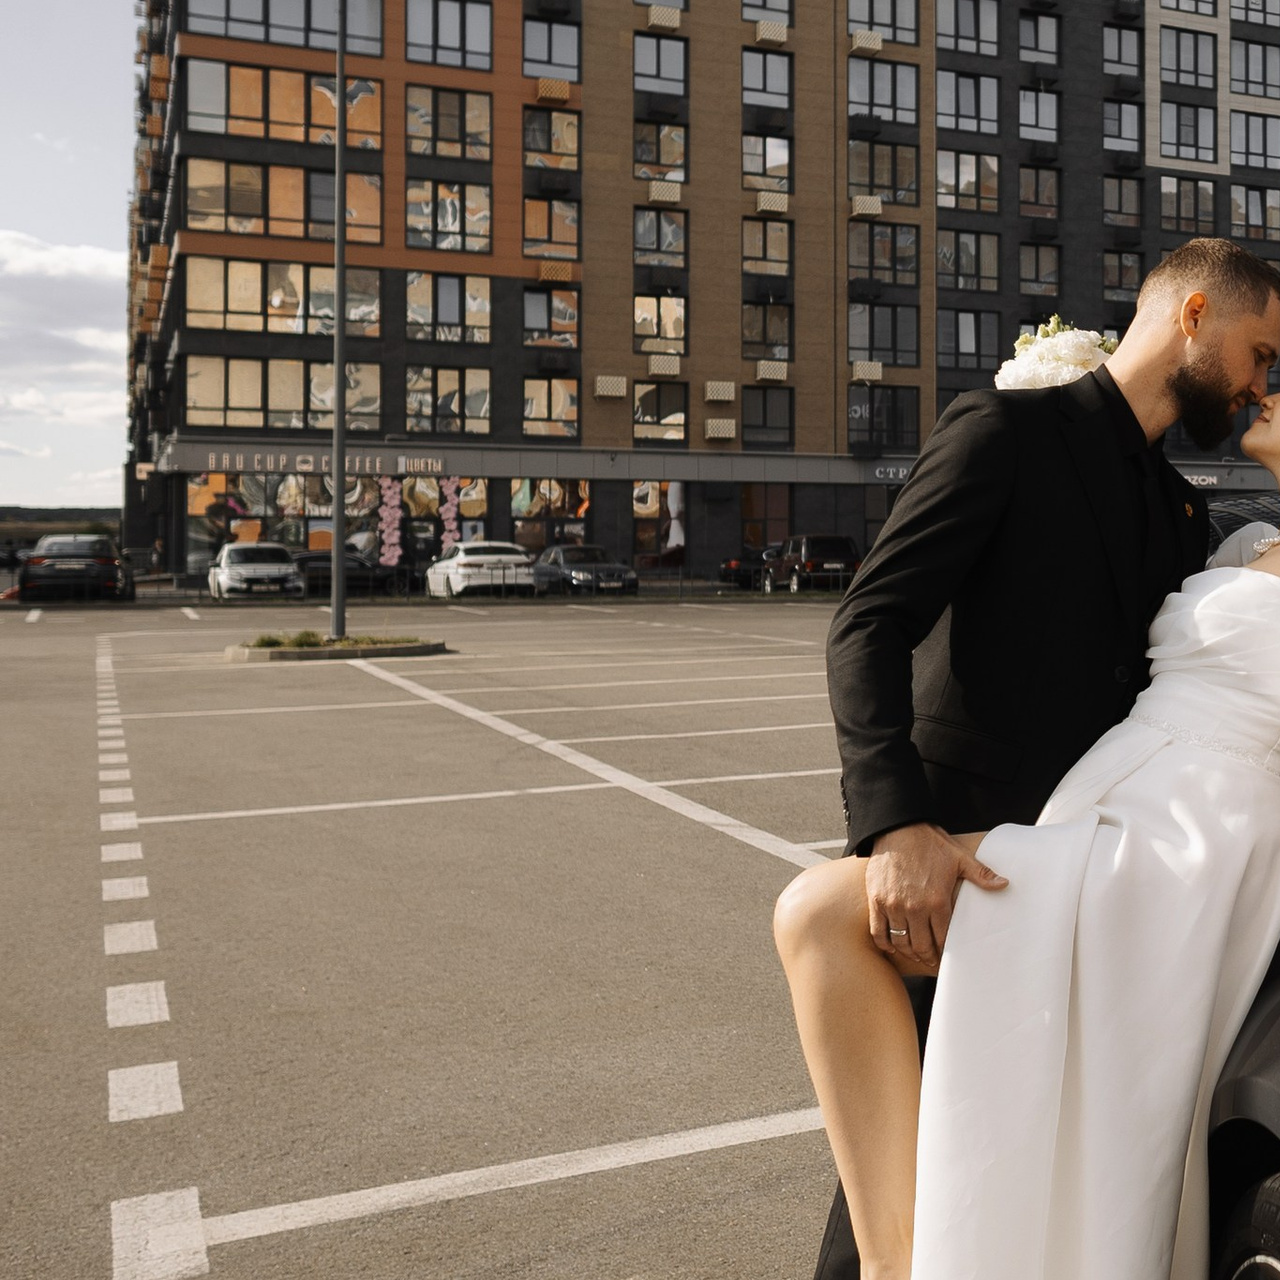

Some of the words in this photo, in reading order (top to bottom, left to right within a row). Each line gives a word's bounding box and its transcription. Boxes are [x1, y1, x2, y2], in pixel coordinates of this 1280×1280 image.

[254, 453, 287, 471] CUP
[321, 455, 382, 473] CFFEE
[406, 458, 442, 473] ЦВЕТЫ
